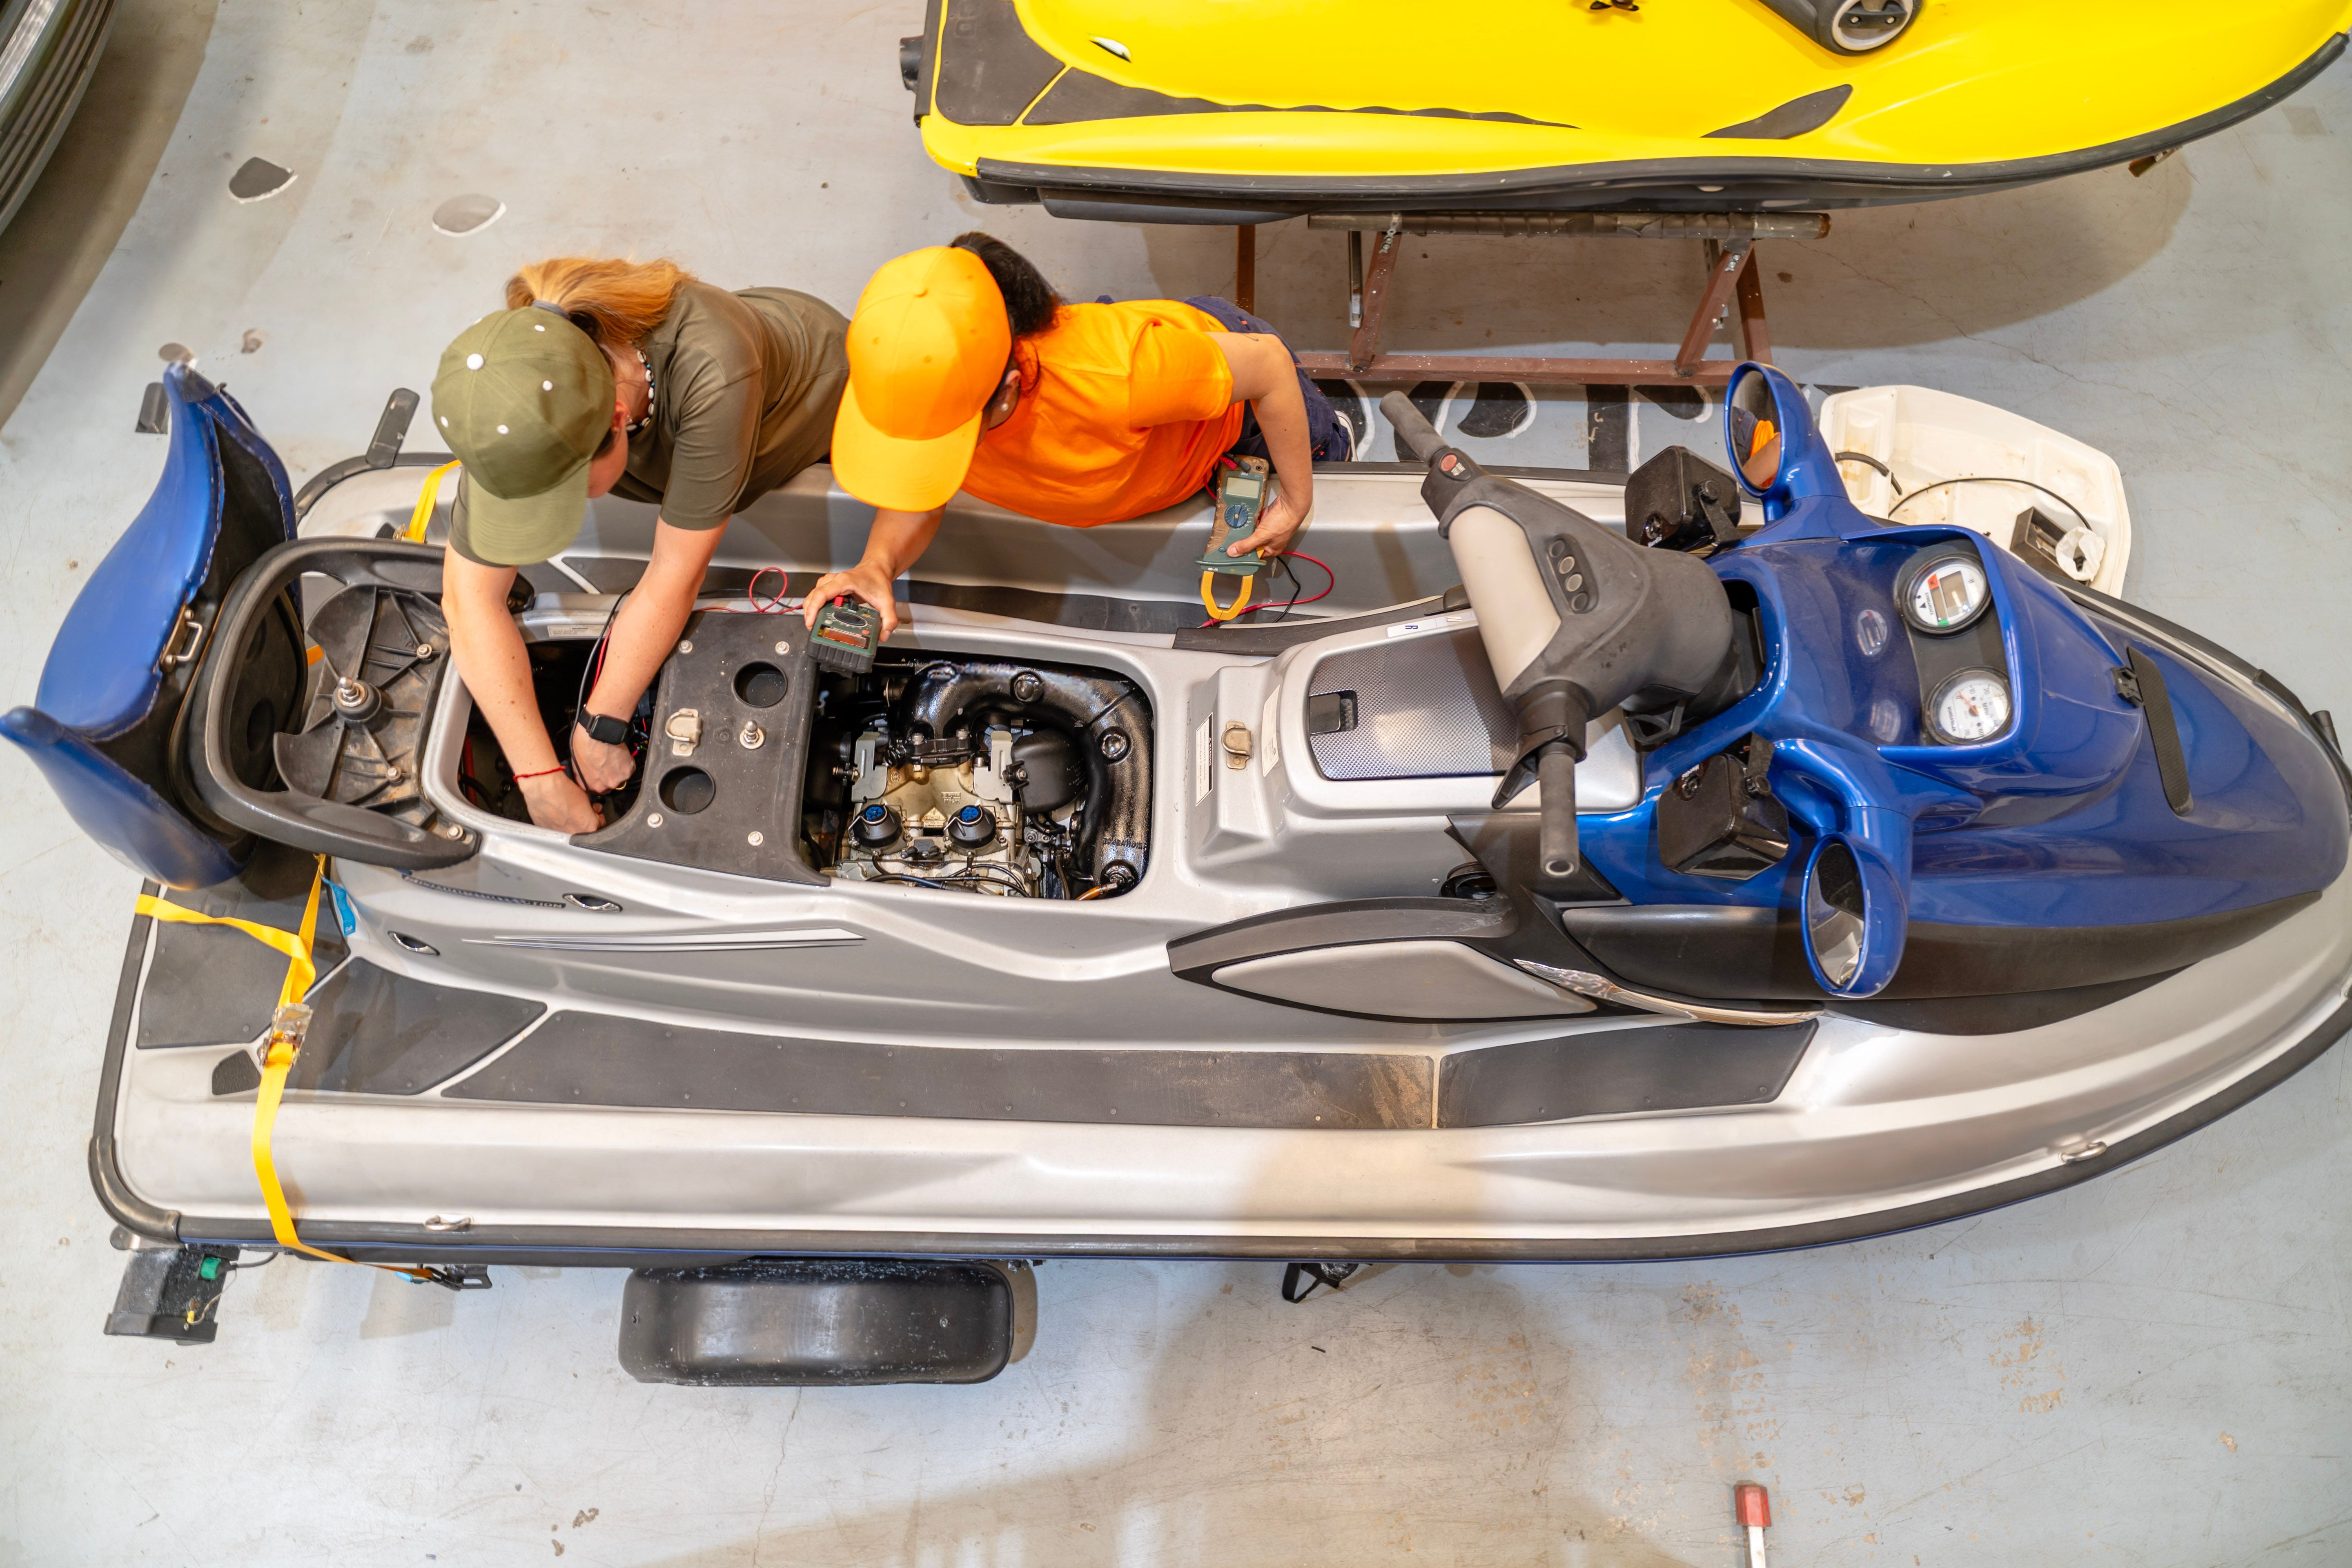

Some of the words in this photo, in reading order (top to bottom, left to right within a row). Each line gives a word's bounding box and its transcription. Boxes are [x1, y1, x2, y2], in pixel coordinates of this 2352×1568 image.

[1451, 467, 1460, 476] STOP
[1456, 463, 1466, 472] START
[1982, 702, 1991, 716] MPH
[1978, 728, 1985, 737] 60
